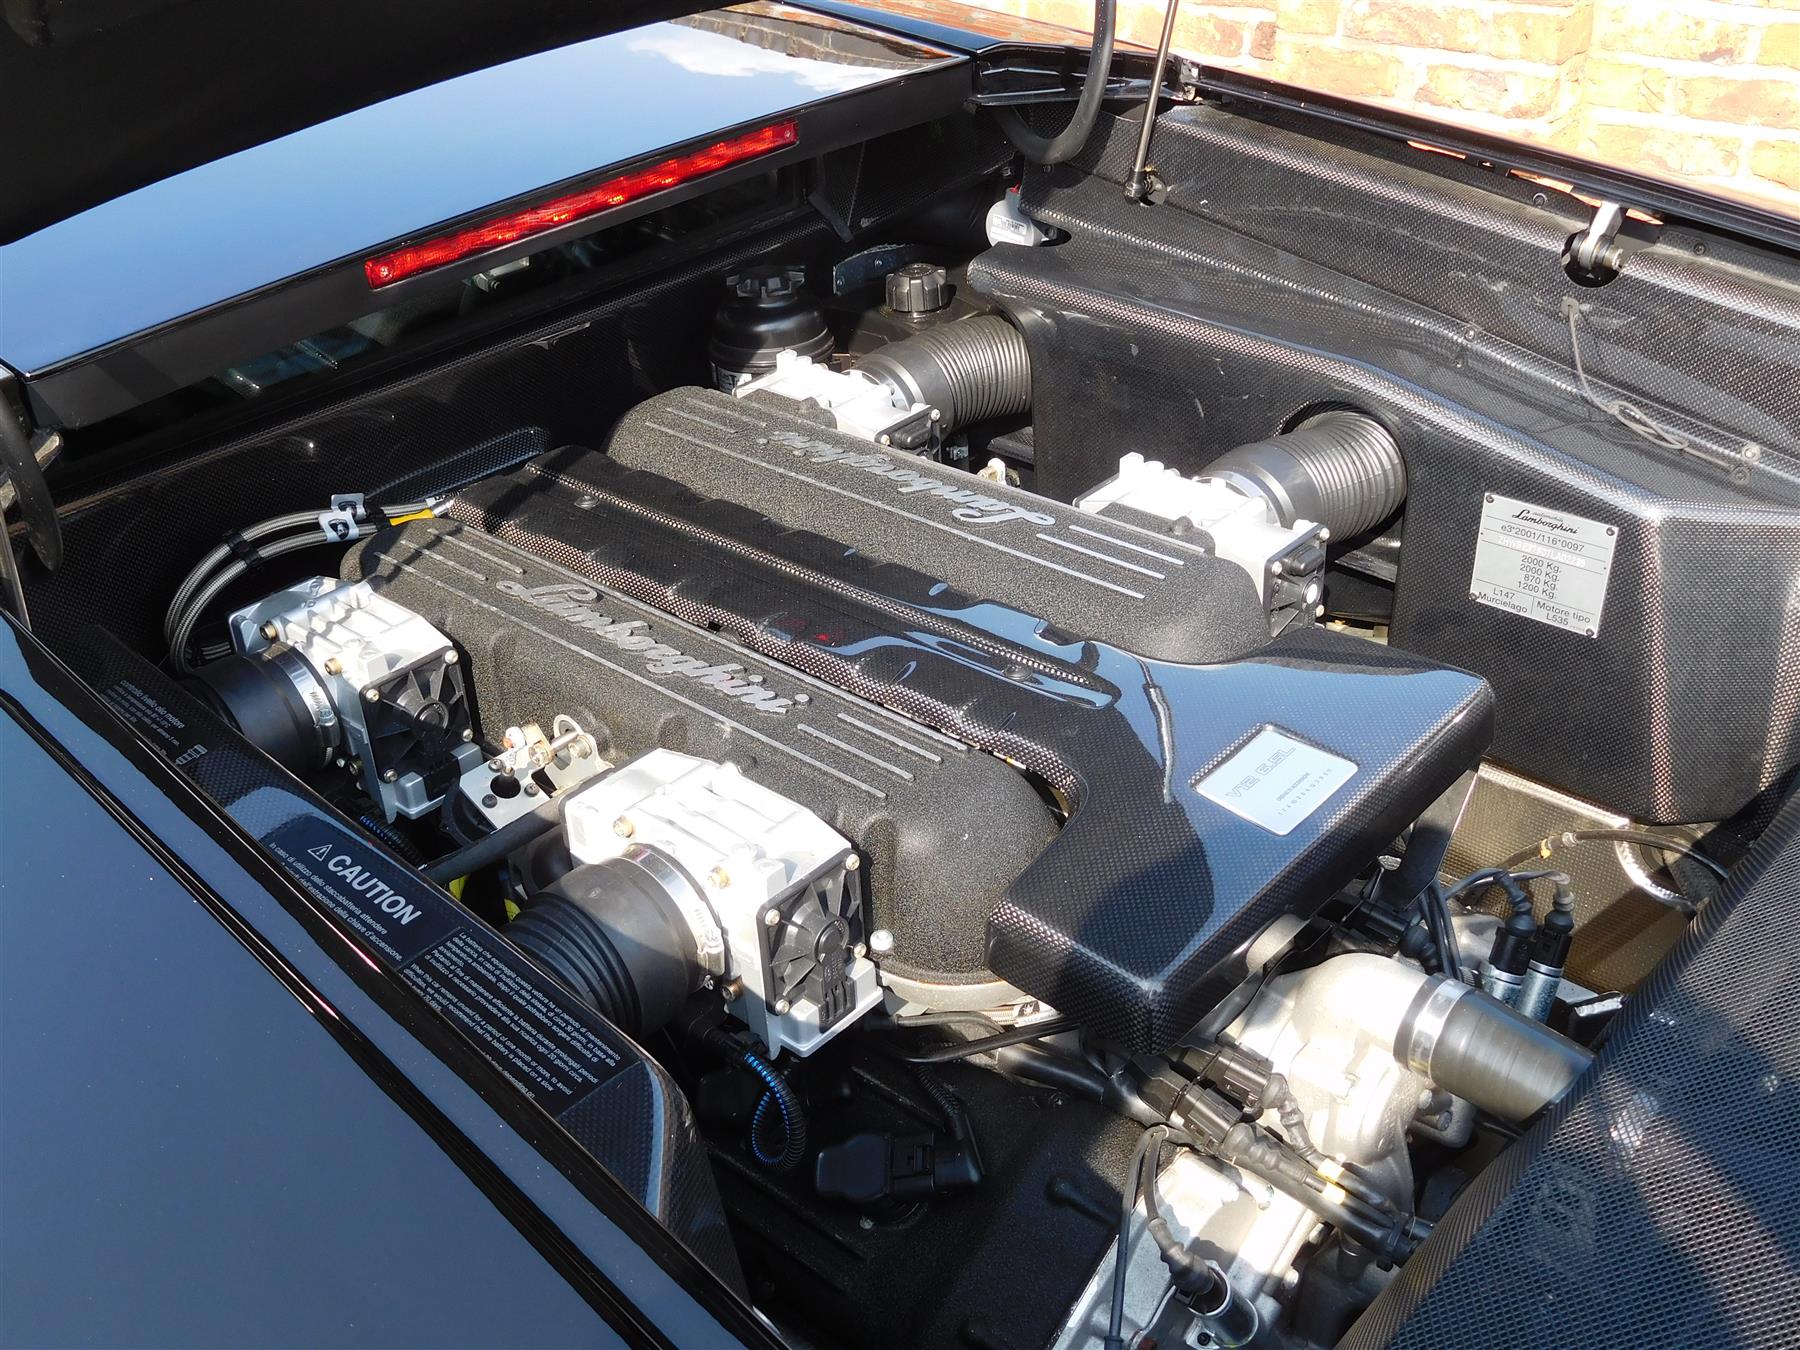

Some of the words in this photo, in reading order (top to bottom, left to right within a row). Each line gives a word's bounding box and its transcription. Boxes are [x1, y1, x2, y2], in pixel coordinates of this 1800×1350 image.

[1512, 509, 1579, 534] Lamborghini
[1517, 581, 1540, 593] 1200
[1520, 564, 1542, 576] 2000
[1544, 570, 1559, 582] Kg.
[1521, 555, 1544, 567] 2000
[1524, 573, 1541, 585] 870
[1478, 591, 1528, 613] Murcielago
[1493, 587, 1515, 599] L147
[1537, 601, 1570, 618] Motore
[1573, 611, 1591, 624] tipo
[1546, 613, 1569, 625] L535
[496, 580, 810, 714] Lamborghini
[273, 846, 289, 858] caso
[291, 860, 314, 876] utilizzo
[309, 874, 327, 886] dello
[322, 884, 363, 915] staccabatteria
[358, 912, 388, 935] attendere
[327, 855, 422, 925] CAUTION
[332, 905, 350, 918] della
[345, 915, 368, 932] chiave
[364, 929, 403, 962] d'accensione.
[430, 949, 452, 966] Pertanto
[453, 968, 465, 977] fine
[467, 979, 494, 1000] mantenere
[490, 998, 514, 1016] efficiente
[516, 1018, 538, 1035] batteria
[535, 1033, 556, 1050] durante
[552, 1048, 581, 1070] prolungati
[577, 1067, 598, 1084] periodi
[442, 941, 473, 964] temperatura
[494, 981, 511, 994] dopo
[510, 994, 527, 1007] quale
[523, 1004, 553, 1027] potrebbero
[549, 1025, 571, 1042] sorgere
[451, 936, 464, 947] della
[481, 961, 495, 971] caso
[517, 989, 532, 1000] della
[551, 1015, 566, 1027] circa
[569, 1030, 588, 1045] giorni,
[591, 1047, 607, 1059] base
[604, 1057, 616, 1066] alla
[464, 937, 484, 952] batteria
[480, 950, 492, 959] che
[488, 957, 517, 979] equipaggia
[512, 976, 533, 991] questa
[529, 988, 549, 1003] vettura
[546, 1001, 556, 1009] ha
[558, 1012, 581, 1029] periodo
[583, 1031, 621, 1060] mantenimento
[420, 973, 432, 982] this
[429, 981, 439, 989] car
[437, 986, 458, 1003] remains
[455, 1001, 475, 1016] unused
[471, 1014, 482, 1022] for
[482, 1023, 501, 1038] period
[503, 1040, 515, 1050] one
[513, 1048, 532, 1062] month
[533, 1066, 551, 1079] more,
[555, 1081, 572, 1095] avoid
[431, 992, 448, 1005] would
[445, 1003, 475, 1027] recommend
[472, 1025, 485, 1035] that
[482, 1033, 493, 1041] the
[489, 1039, 509, 1055] battery
[510, 1057, 531, 1073] placed
[539, 1080, 554, 1091] slow
[450, 976, 477, 997] necessario
[473, 995, 502, 1018] provvedere
[499, 1015, 511, 1024] alla
[508, 1023, 519, 1032] sua
[517, 1030, 538, 1046] ricarica
[534, 1044, 549, 1055] ogni
[552, 1058, 570, 1072] giorni
